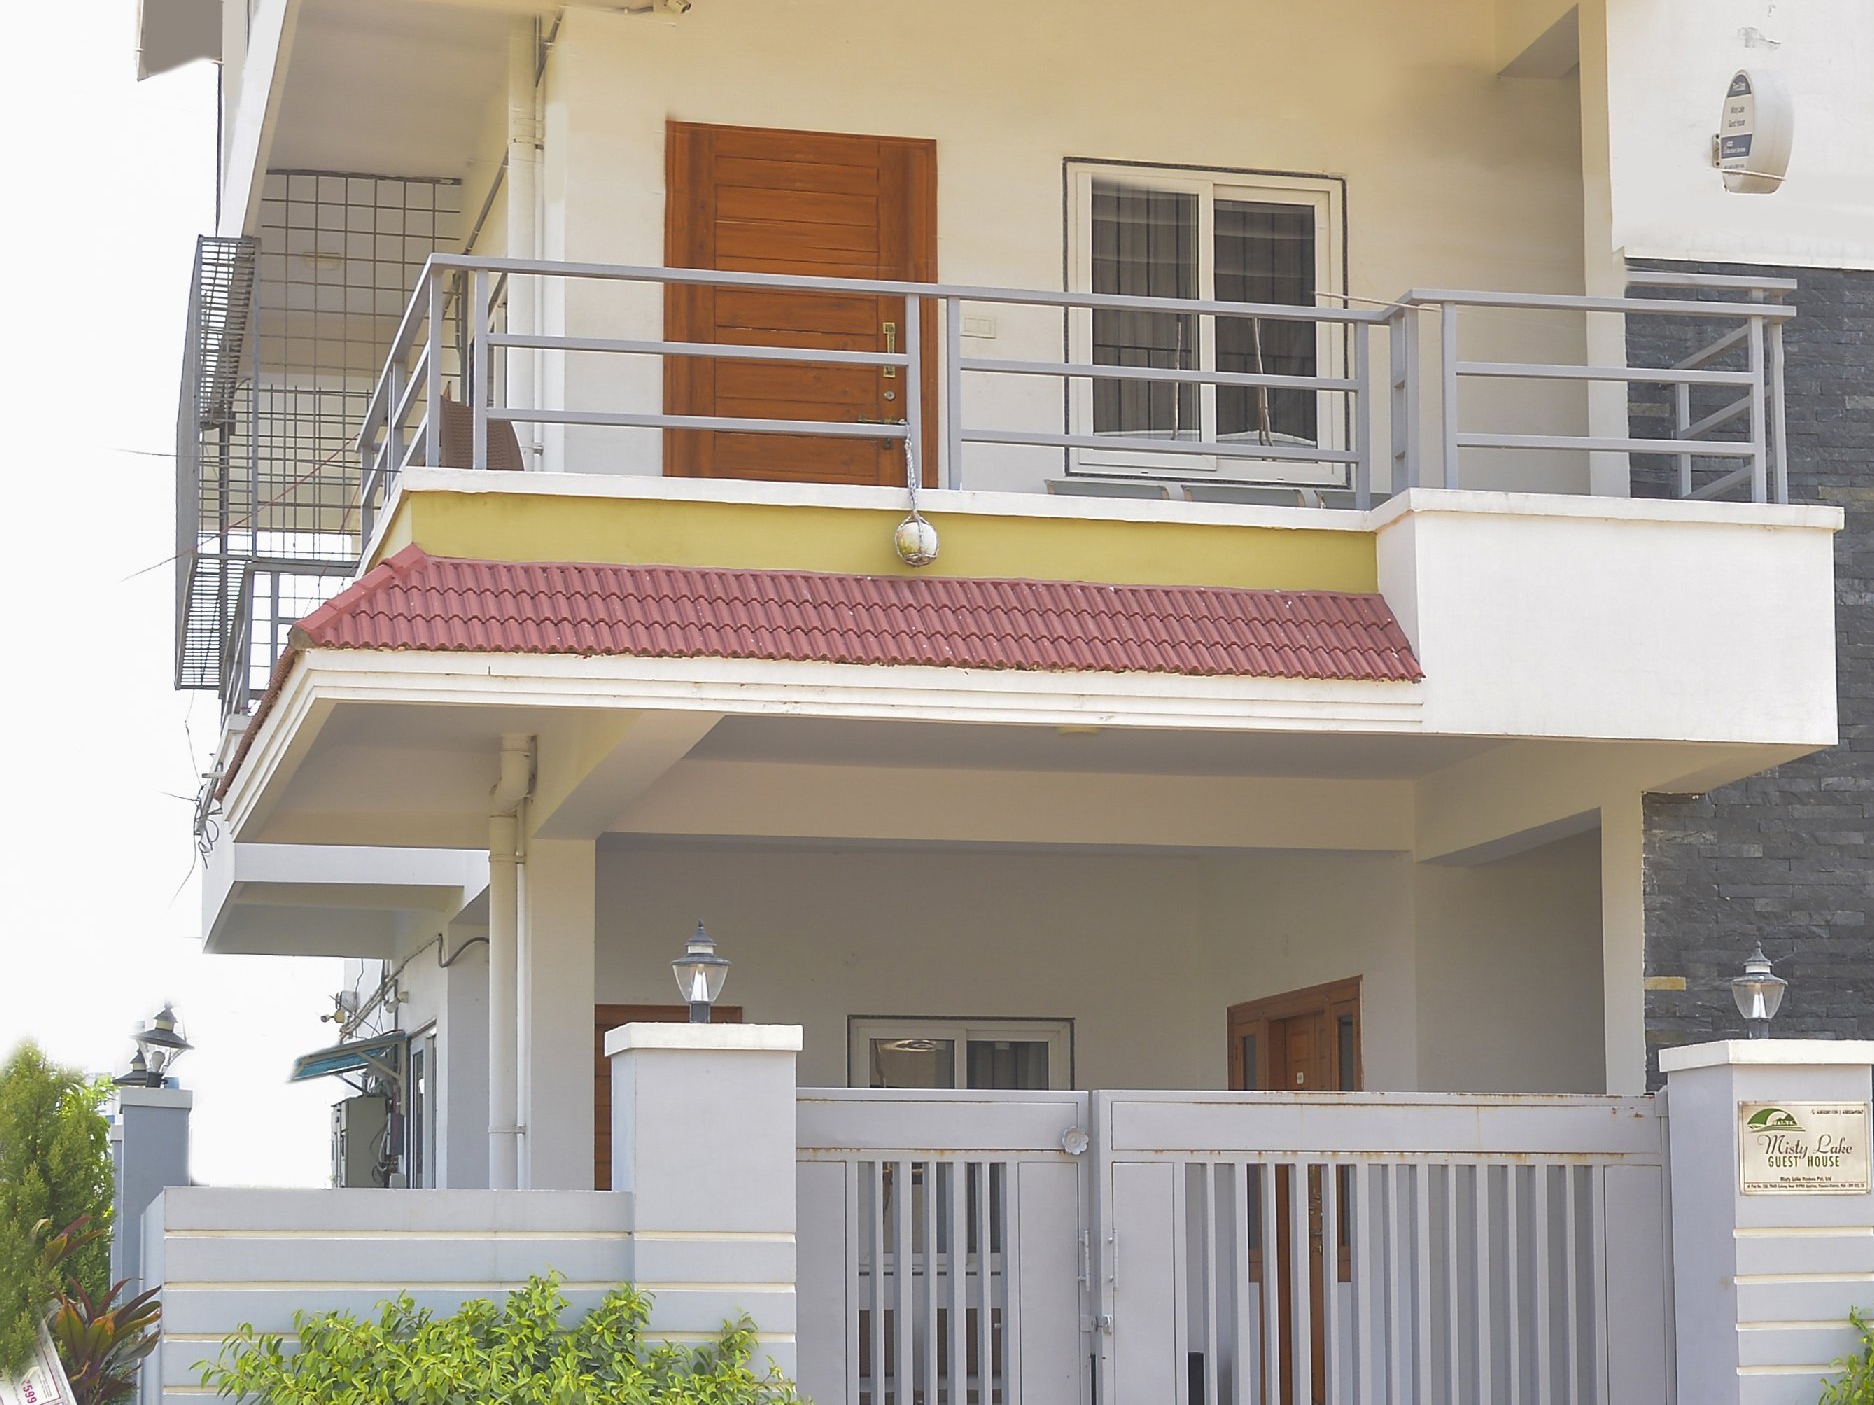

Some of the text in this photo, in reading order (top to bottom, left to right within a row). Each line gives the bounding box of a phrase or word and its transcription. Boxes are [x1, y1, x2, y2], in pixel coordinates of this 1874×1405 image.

[1757, 1134, 1853, 1159] Misty Lake
[1767, 1155, 1840, 1168] GUEST HOUSE
